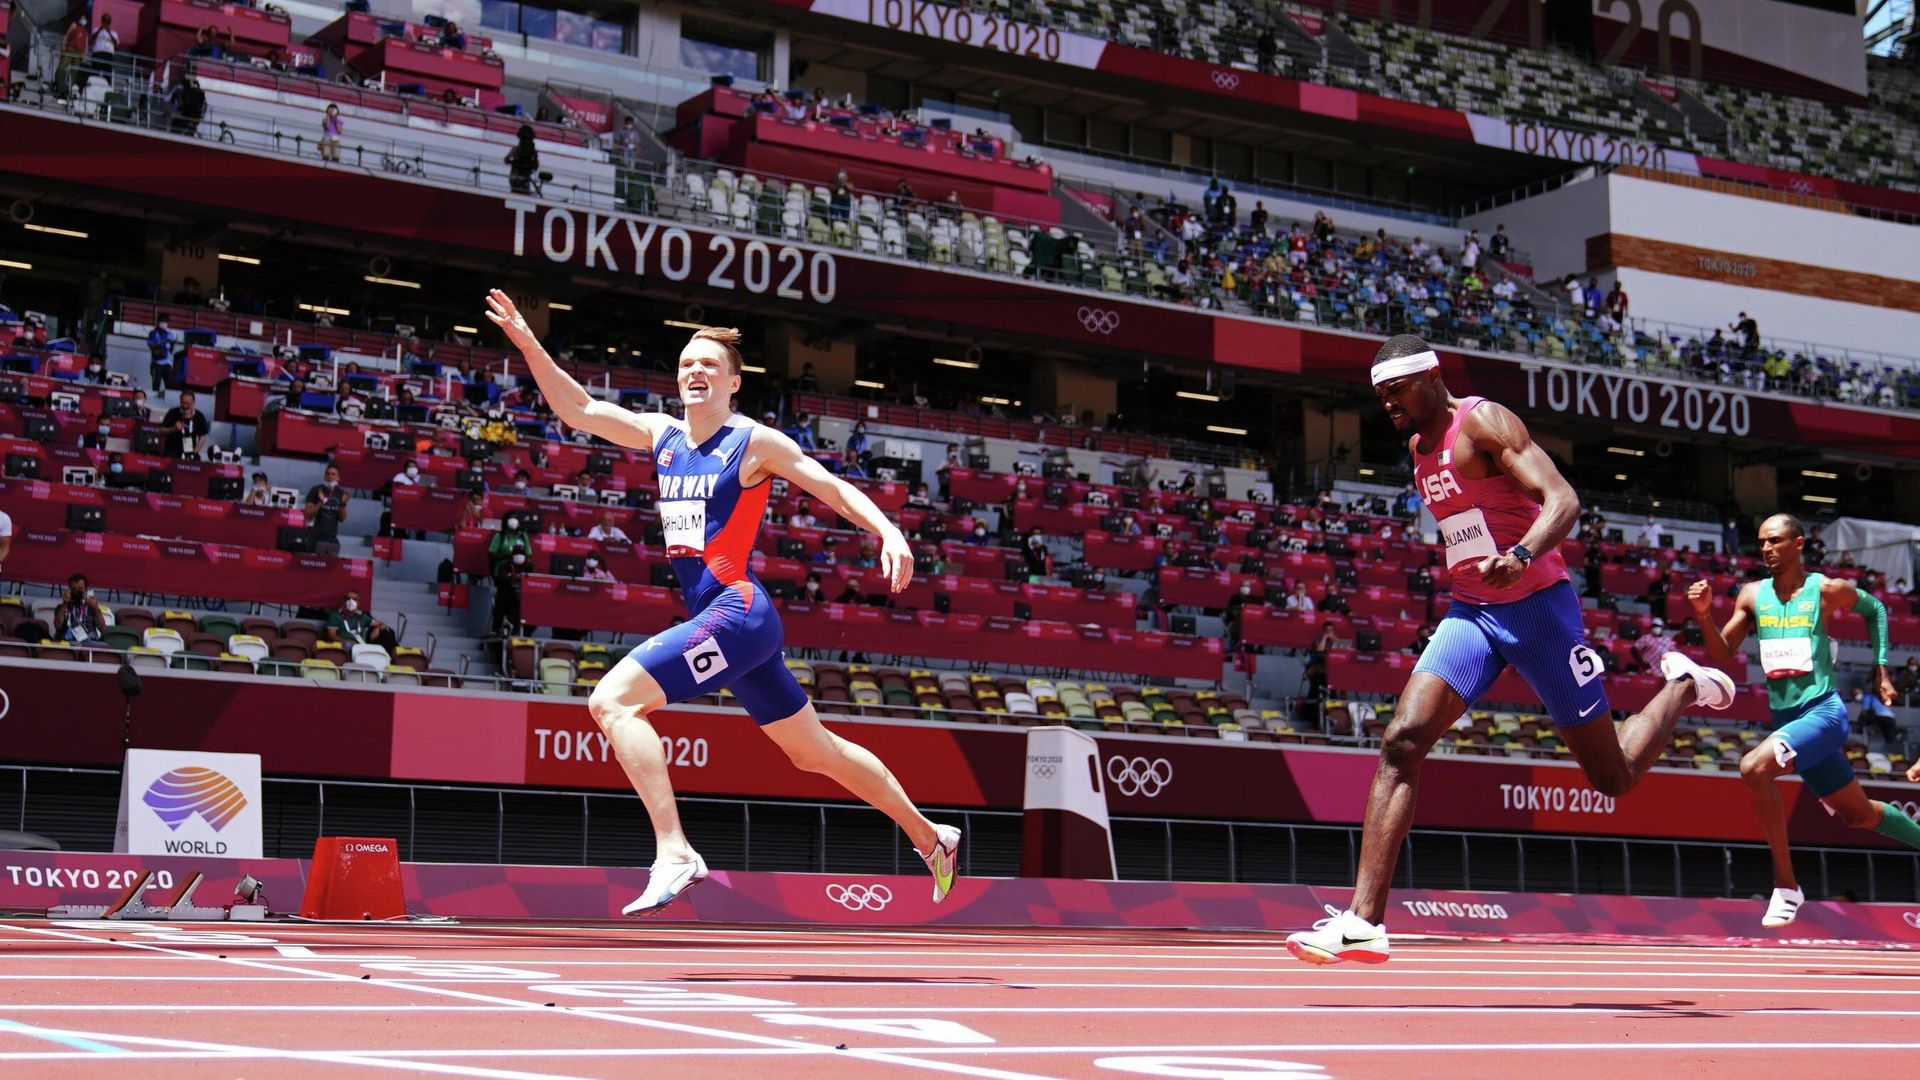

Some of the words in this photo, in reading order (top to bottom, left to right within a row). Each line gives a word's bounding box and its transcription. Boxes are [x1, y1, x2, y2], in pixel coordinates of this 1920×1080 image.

[983, 15, 1060, 61] 2020
[1506, 119, 1594, 164] TOKYO
[505, 200, 692, 281] TOKYO
[708, 235, 836, 304] 2020
[1520, 363, 1649, 423] TOKYO
[1660, 384, 1750, 436] 2020
[1421, 469, 1463, 506] USA
[1759, 614, 1814, 628] BRASIL
[693, 651, 719, 673] 6
[1574, 648, 1594, 677] 5
[534, 729, 611, 762] TOKY
[661, 736, 708, 767] 020
[1500, 784, 1565, 811] TOKYO
[1569, 788, 1616, 814] 2020
[164, 840, 227, 855] WORLD
[355, 844, 389, 853] OMEGA
[6, 866, 100, 889] TOKYO
[1402, 901, 1465, 917] TOKYO
[1463, 903, 1508, 919] 2020
